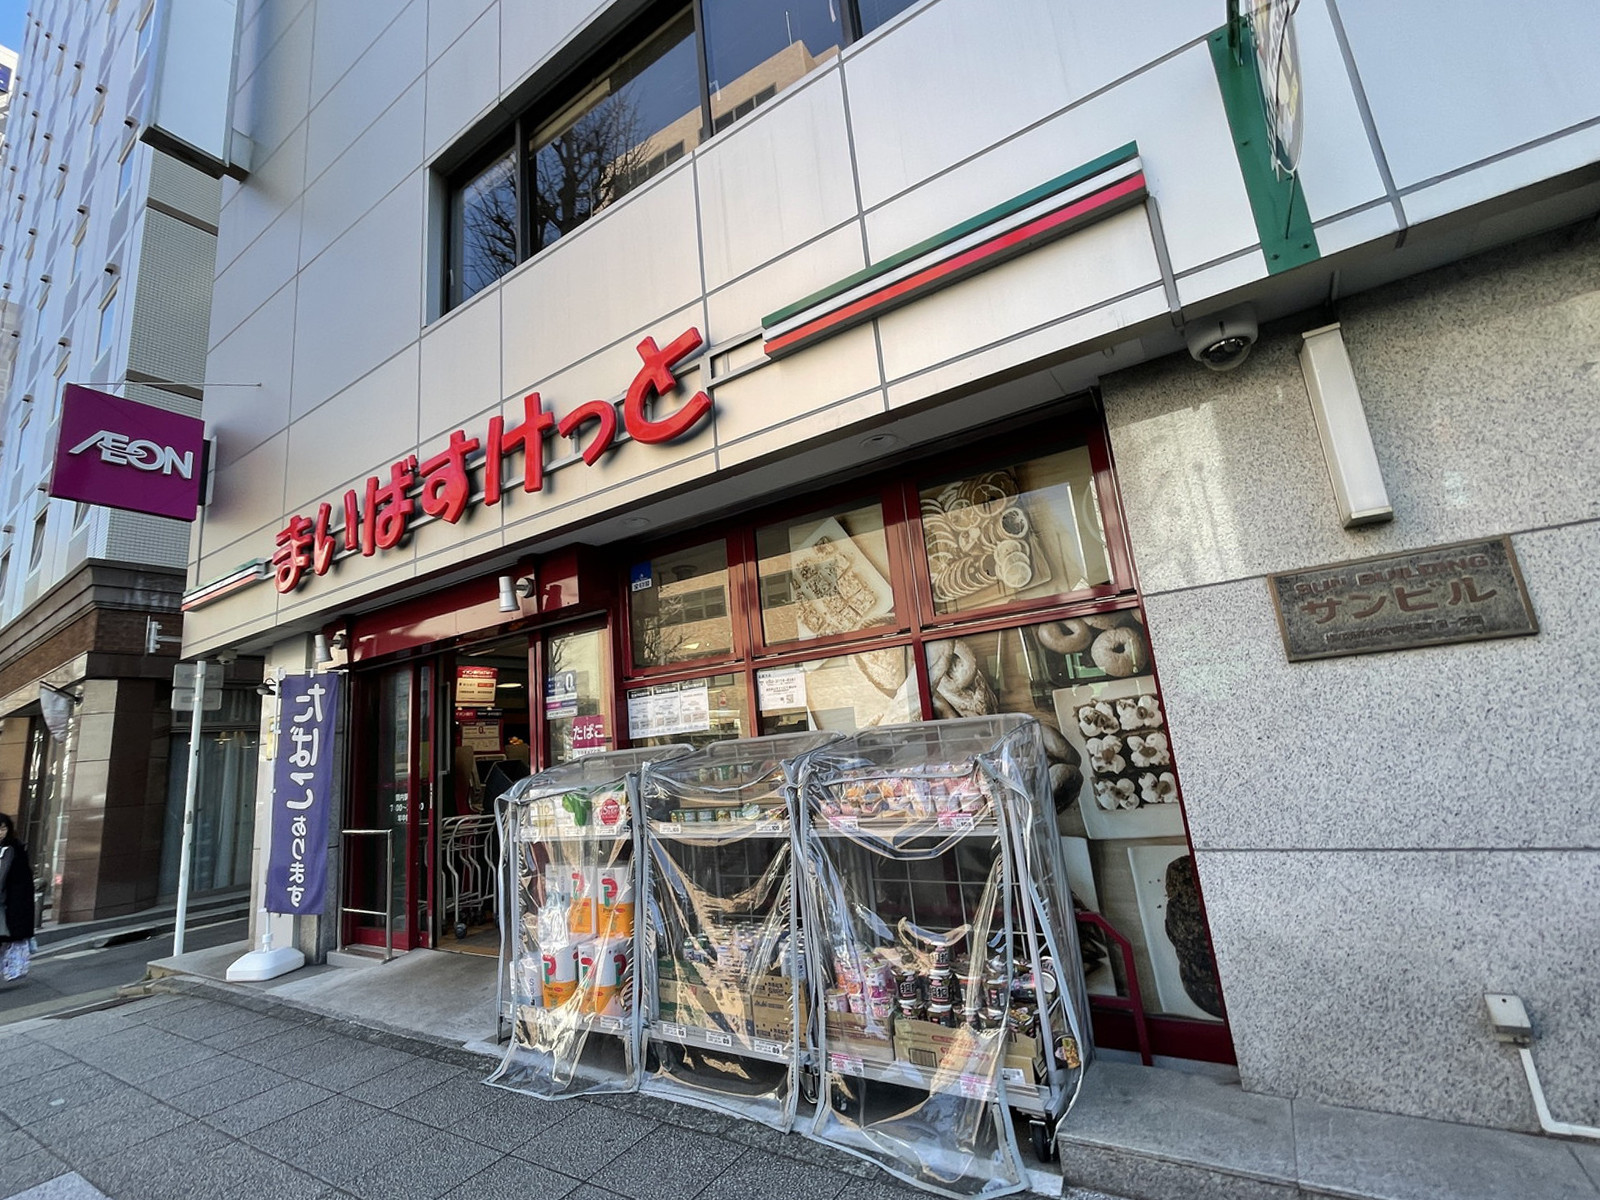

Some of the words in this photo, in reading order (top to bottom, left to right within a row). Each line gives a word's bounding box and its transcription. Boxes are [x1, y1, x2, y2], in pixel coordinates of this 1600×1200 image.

[68, 429, 194, 480] AEON
[272, 326, 712, 594] まいばすけっと
[1355, 553, 1490, 586] BUILDING
[1299, 577, 1498, 625] サンビル
[572, 723, 605, 741] たばこ
